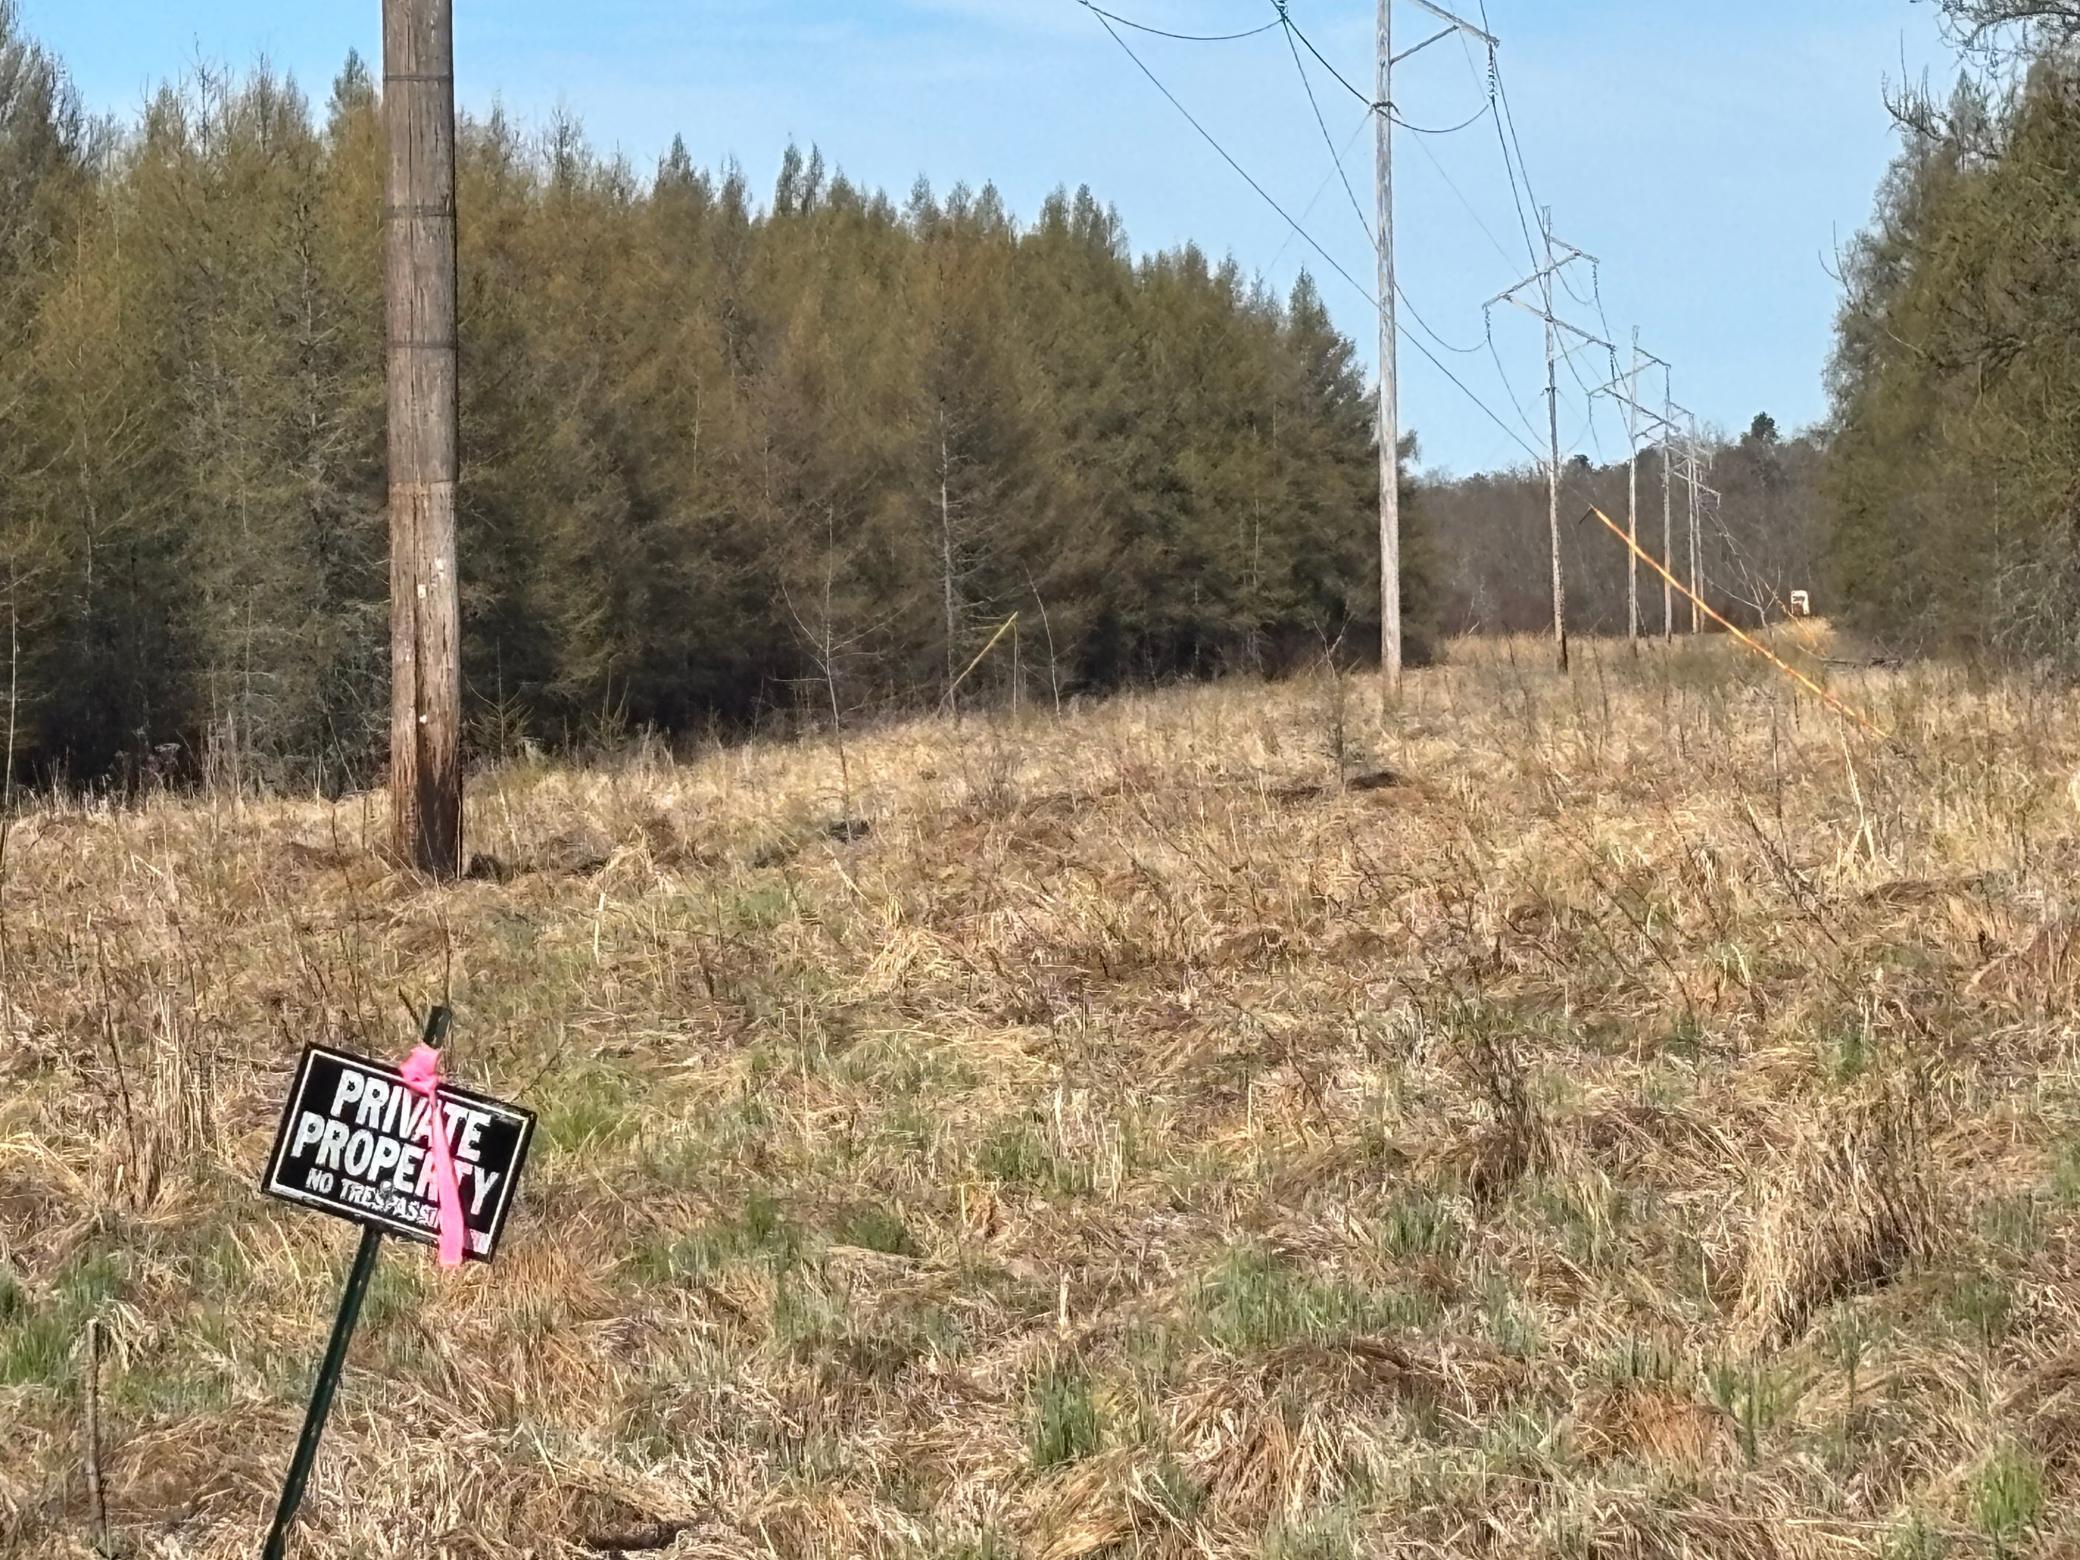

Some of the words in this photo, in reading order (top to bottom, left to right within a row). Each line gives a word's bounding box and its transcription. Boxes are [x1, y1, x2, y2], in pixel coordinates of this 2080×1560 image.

[331, 1069, 490, 1161] PRIVATE
[305, 1168, 334, 1194] NO
[340, 1178, 440, 1229] TRESPASSI
